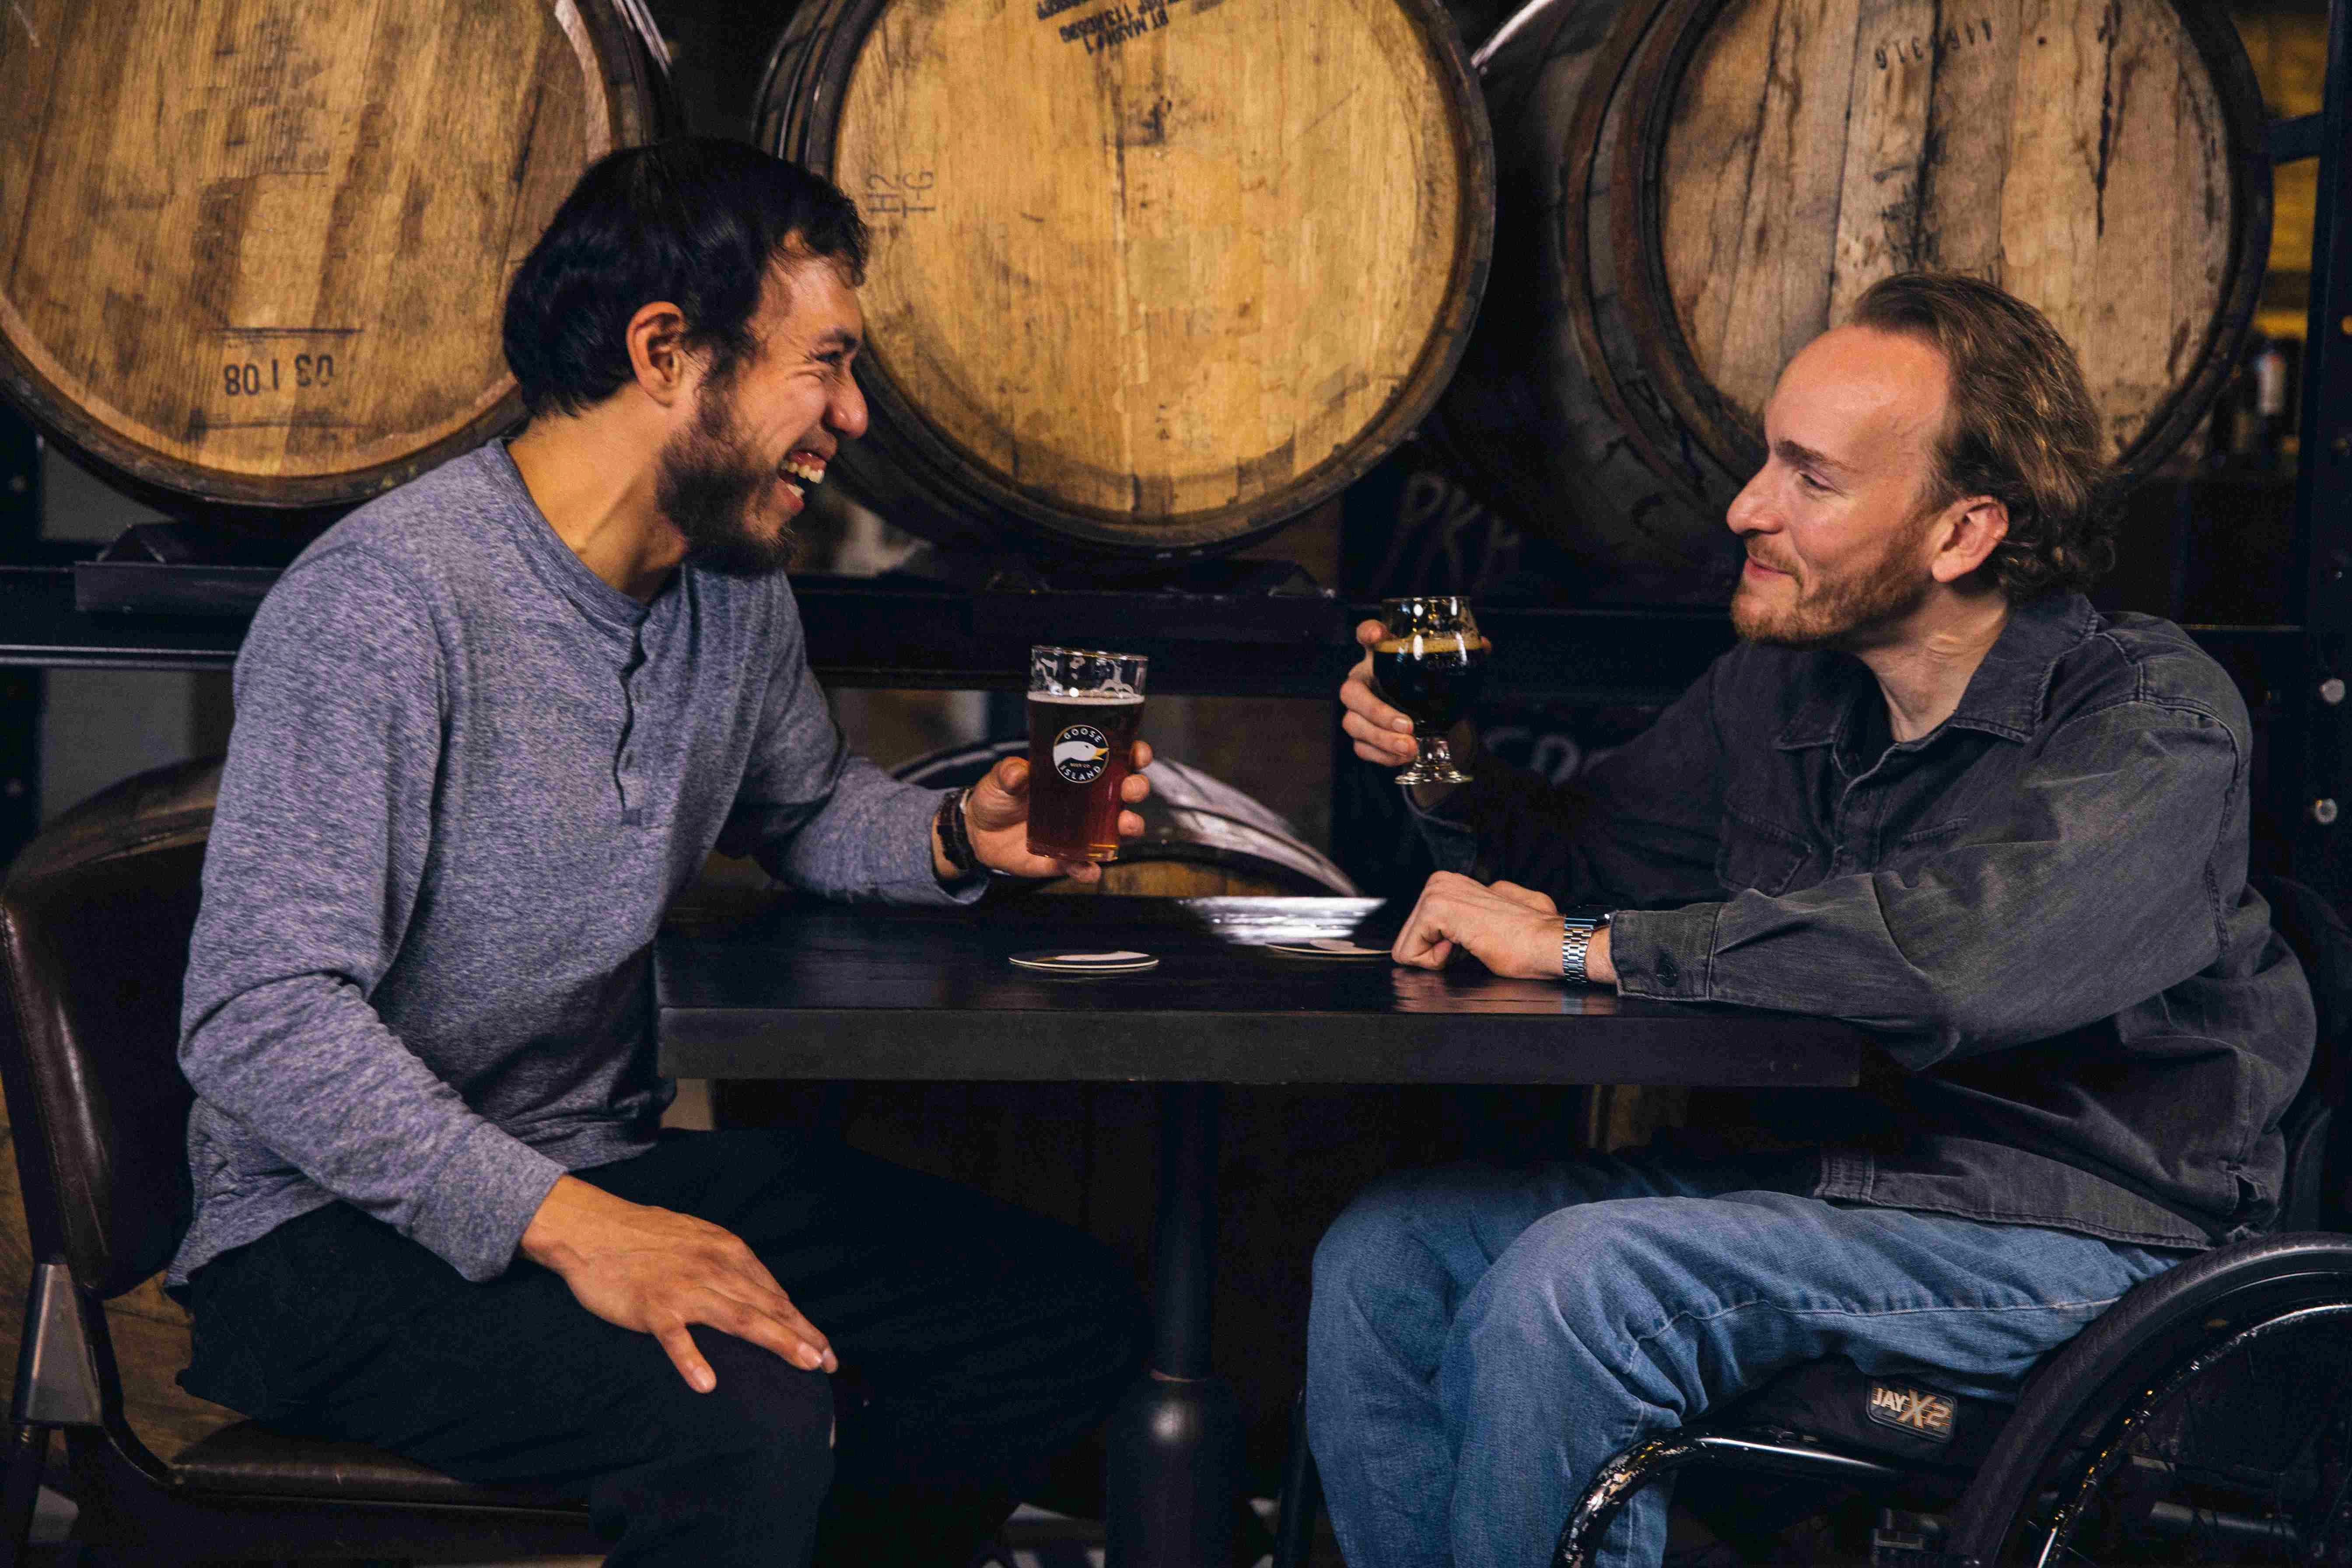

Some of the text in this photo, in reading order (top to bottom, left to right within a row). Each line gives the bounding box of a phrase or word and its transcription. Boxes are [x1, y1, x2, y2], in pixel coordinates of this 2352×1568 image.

[1064, 728, 1102, 743] GOOSE
[1059, 766, 1101, 781] ISLAND
[1871, 1387, 1953, 1428] JAY X2
